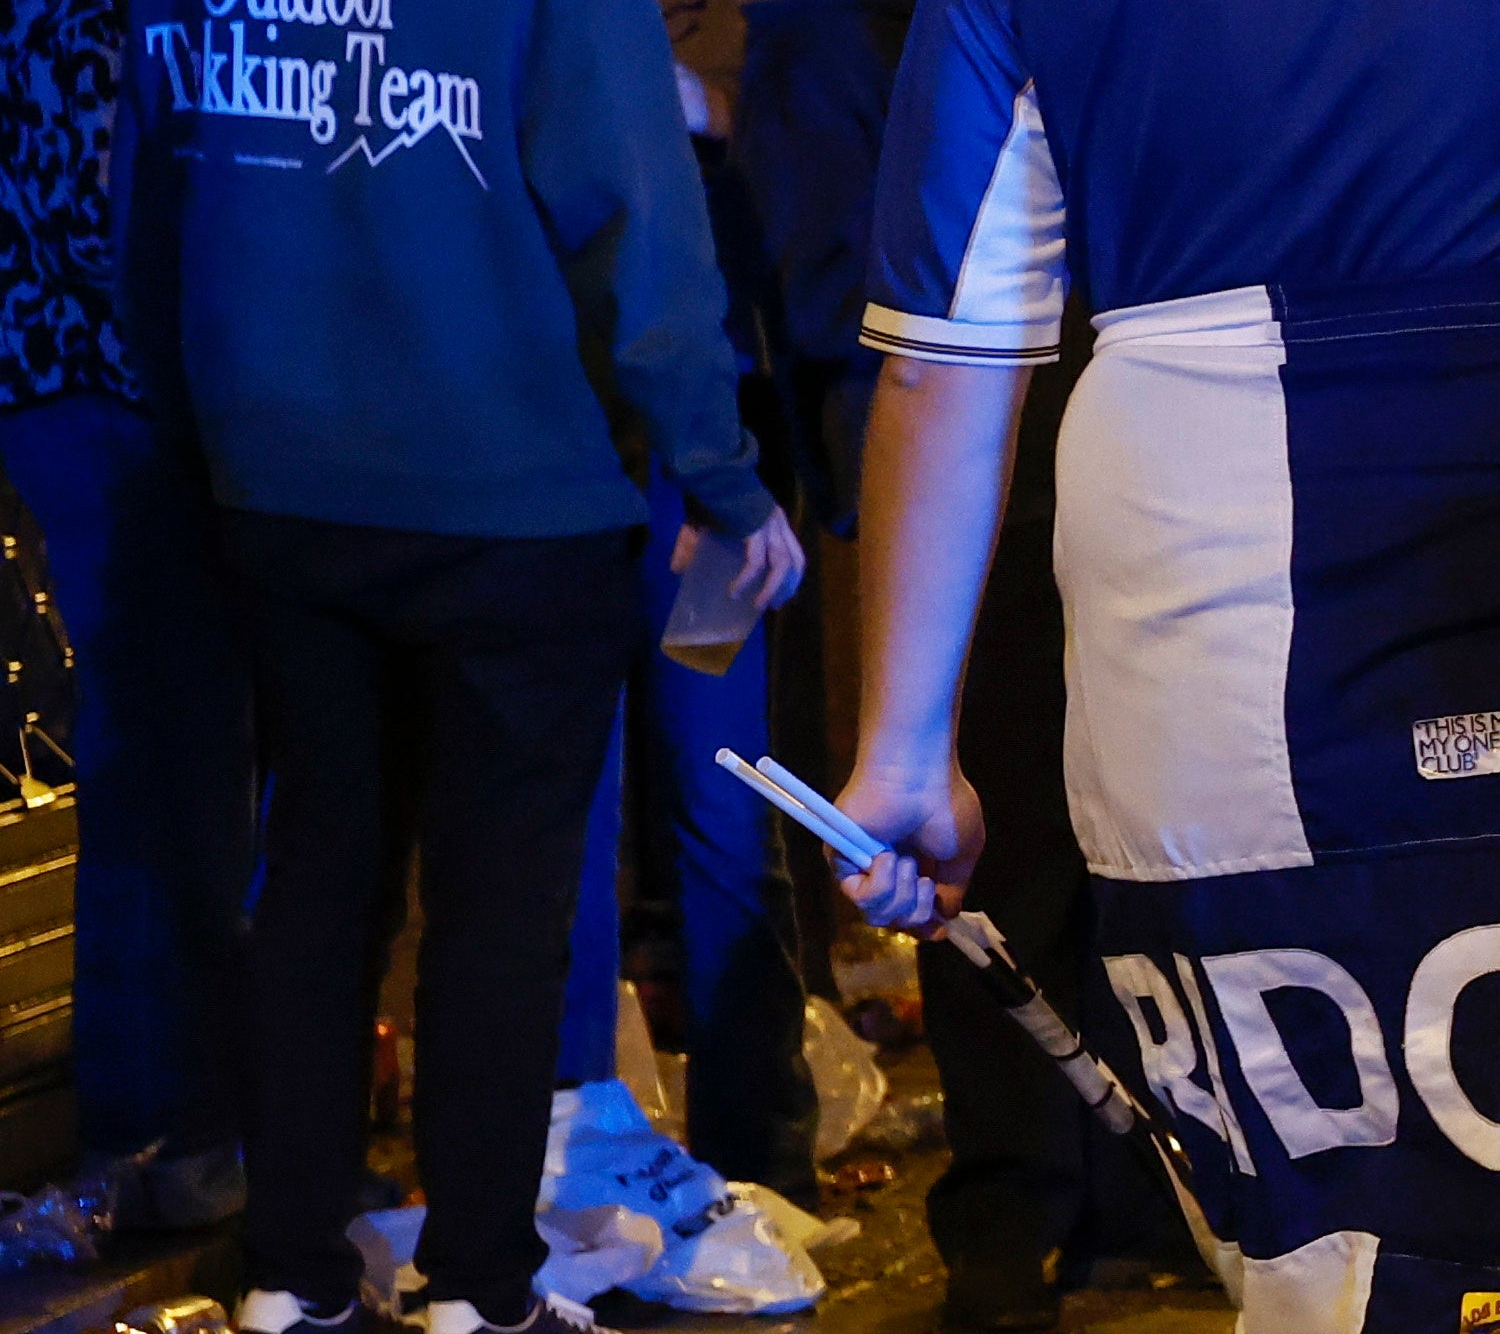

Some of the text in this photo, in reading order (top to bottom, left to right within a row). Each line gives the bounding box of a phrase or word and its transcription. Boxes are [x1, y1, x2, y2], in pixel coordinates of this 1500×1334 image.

[145, 19, 483, 145] Tkking Team
[1471, 715, 1487, 733] IS
[1419, 738, 1448, 757] MY
[1454, 731, 1500, 753] ONE
